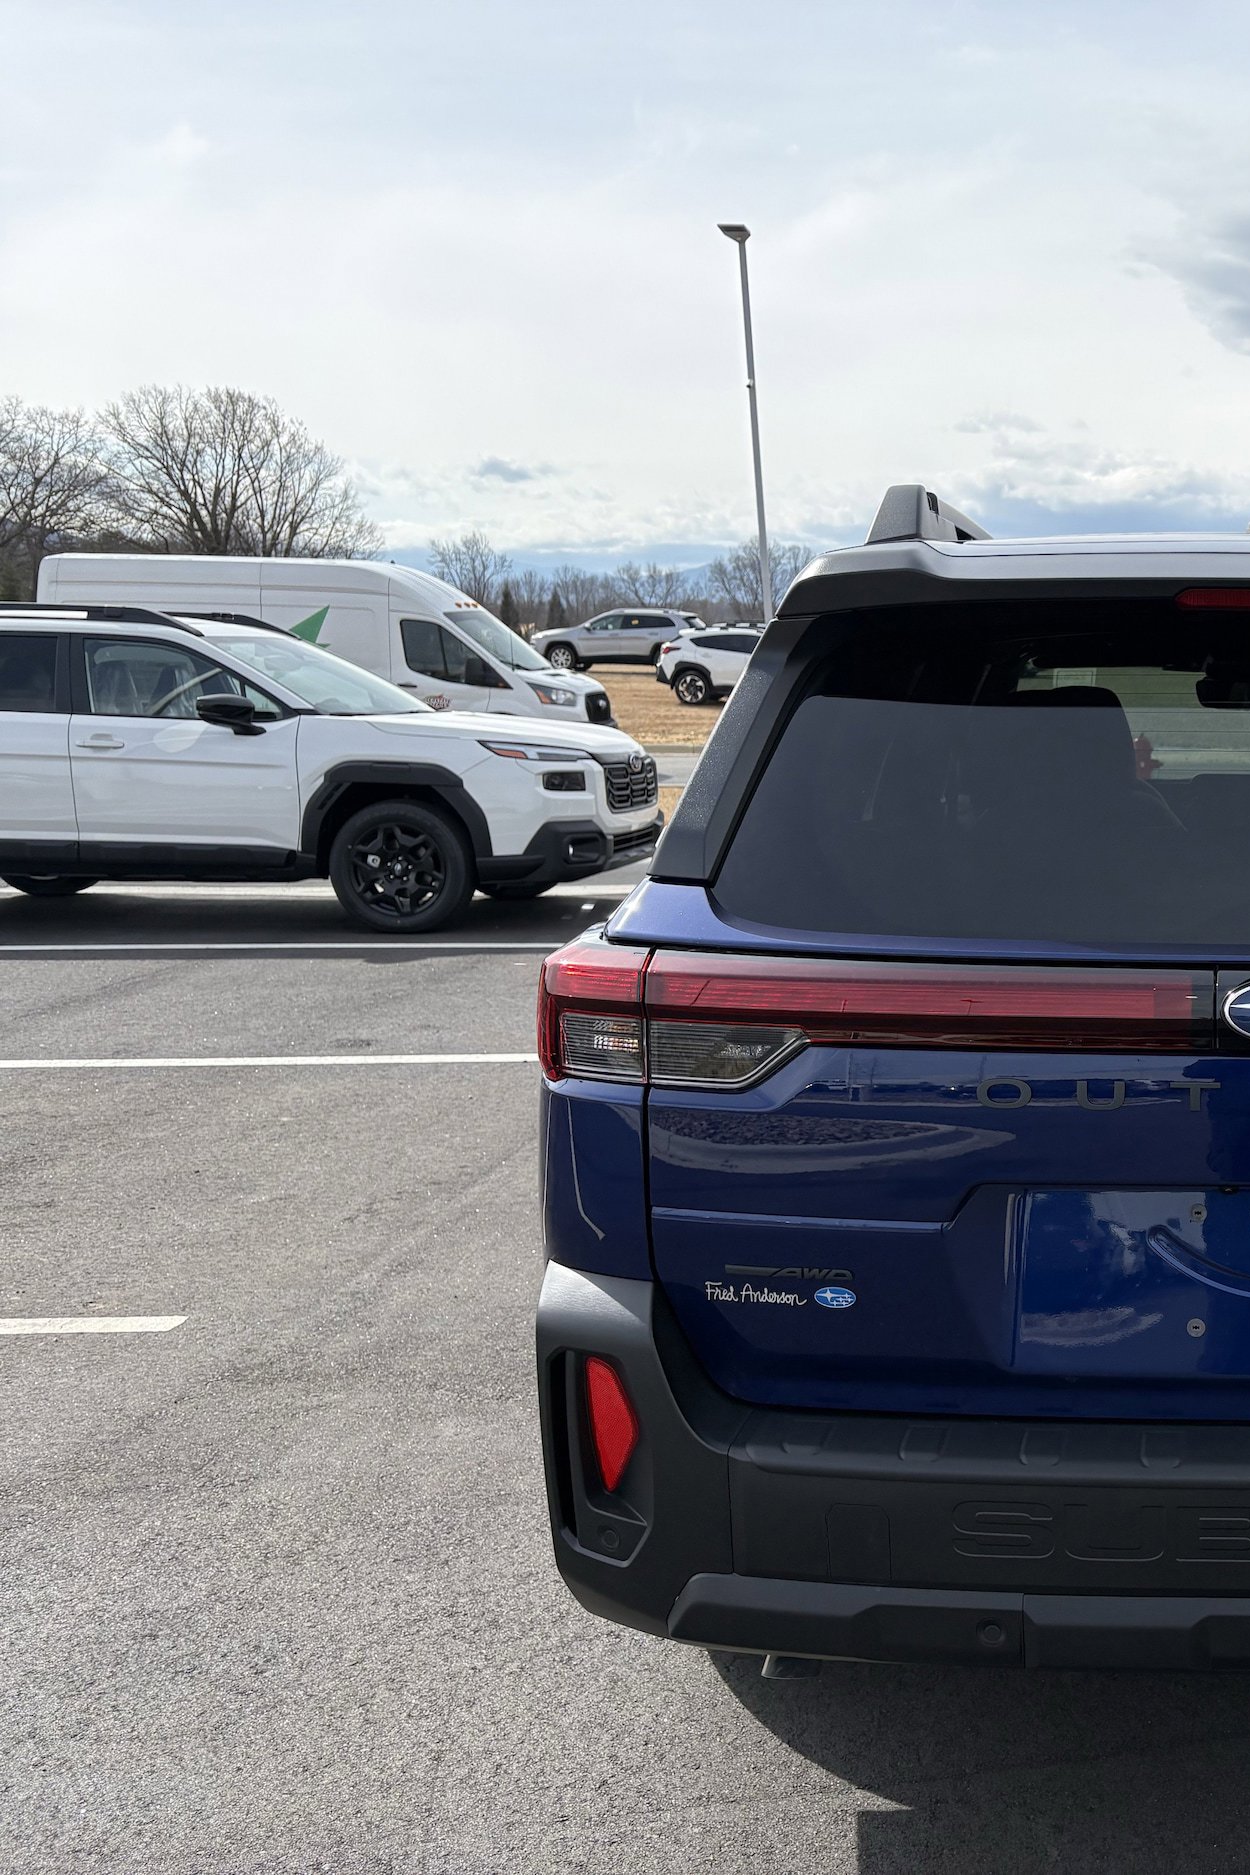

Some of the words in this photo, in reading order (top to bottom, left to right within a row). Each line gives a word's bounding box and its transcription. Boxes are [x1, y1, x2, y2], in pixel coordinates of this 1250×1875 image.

[771, 1266, 854, 1281] AWD
[704, 1280, 739, 1302] Fred
[740, 1282, 808, 1307] Anderson
